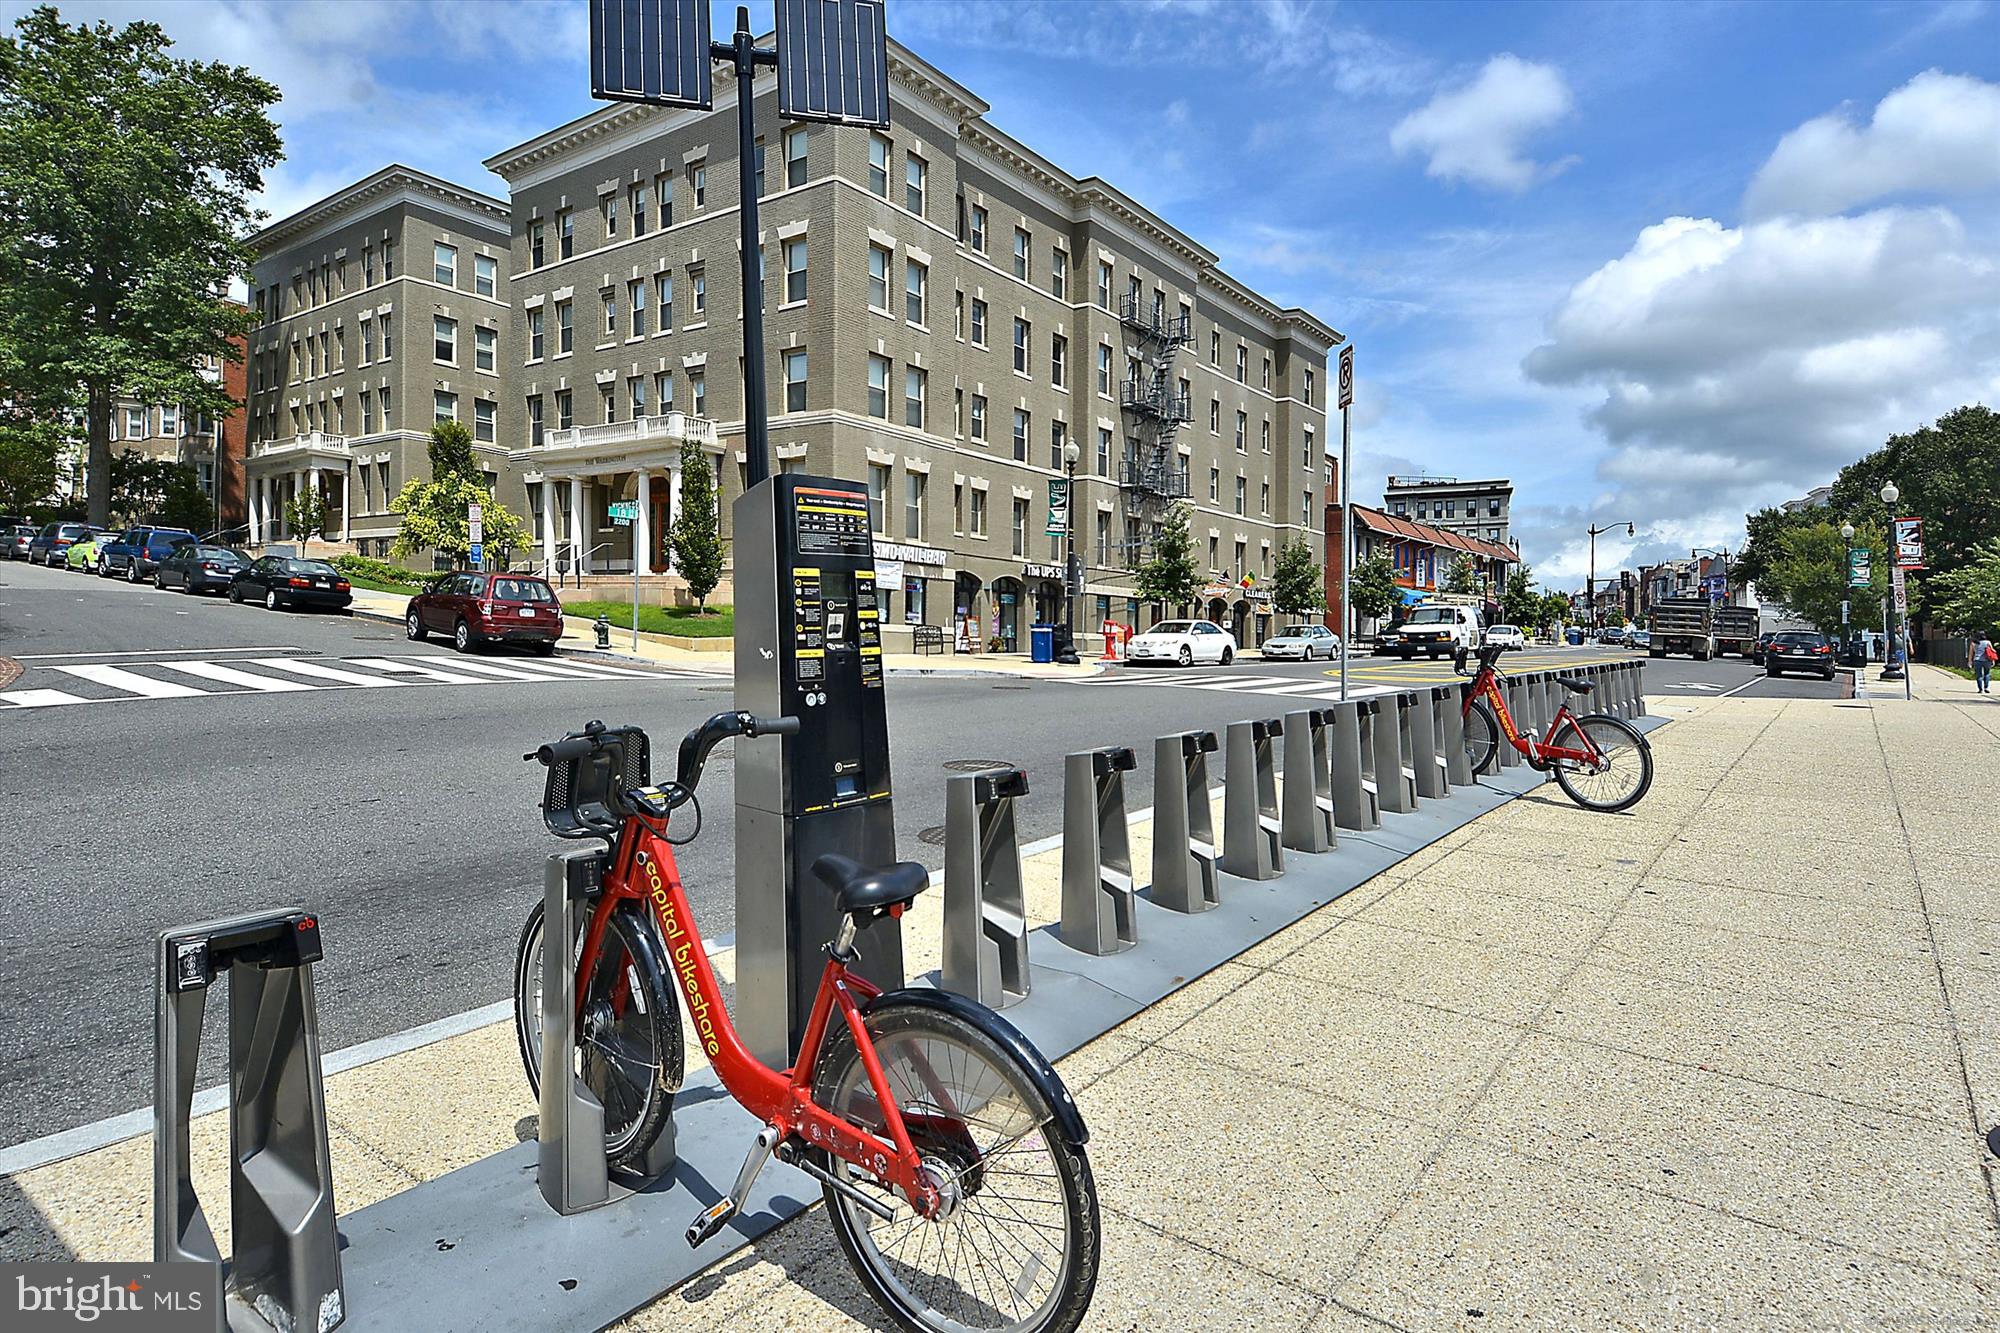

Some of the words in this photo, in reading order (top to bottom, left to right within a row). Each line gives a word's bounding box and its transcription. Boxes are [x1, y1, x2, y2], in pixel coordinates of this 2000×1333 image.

[1050, 483, 1067, 524] LIVE
[614, 518, 630, 526] 2200
[1899, 521, 1921, 557] EAT
[1027, 564, 1040, 577] The
[1041, 566, 1055, 578] UPS
[1852, 551, 1870, 579] LIVE
[1487, 685, 1502, 709] capital
[1498, 709, 1516, 742] bikeshare
[646, 861, 685, 940] capital
[675, 941, 720, 1057] bikeshare
